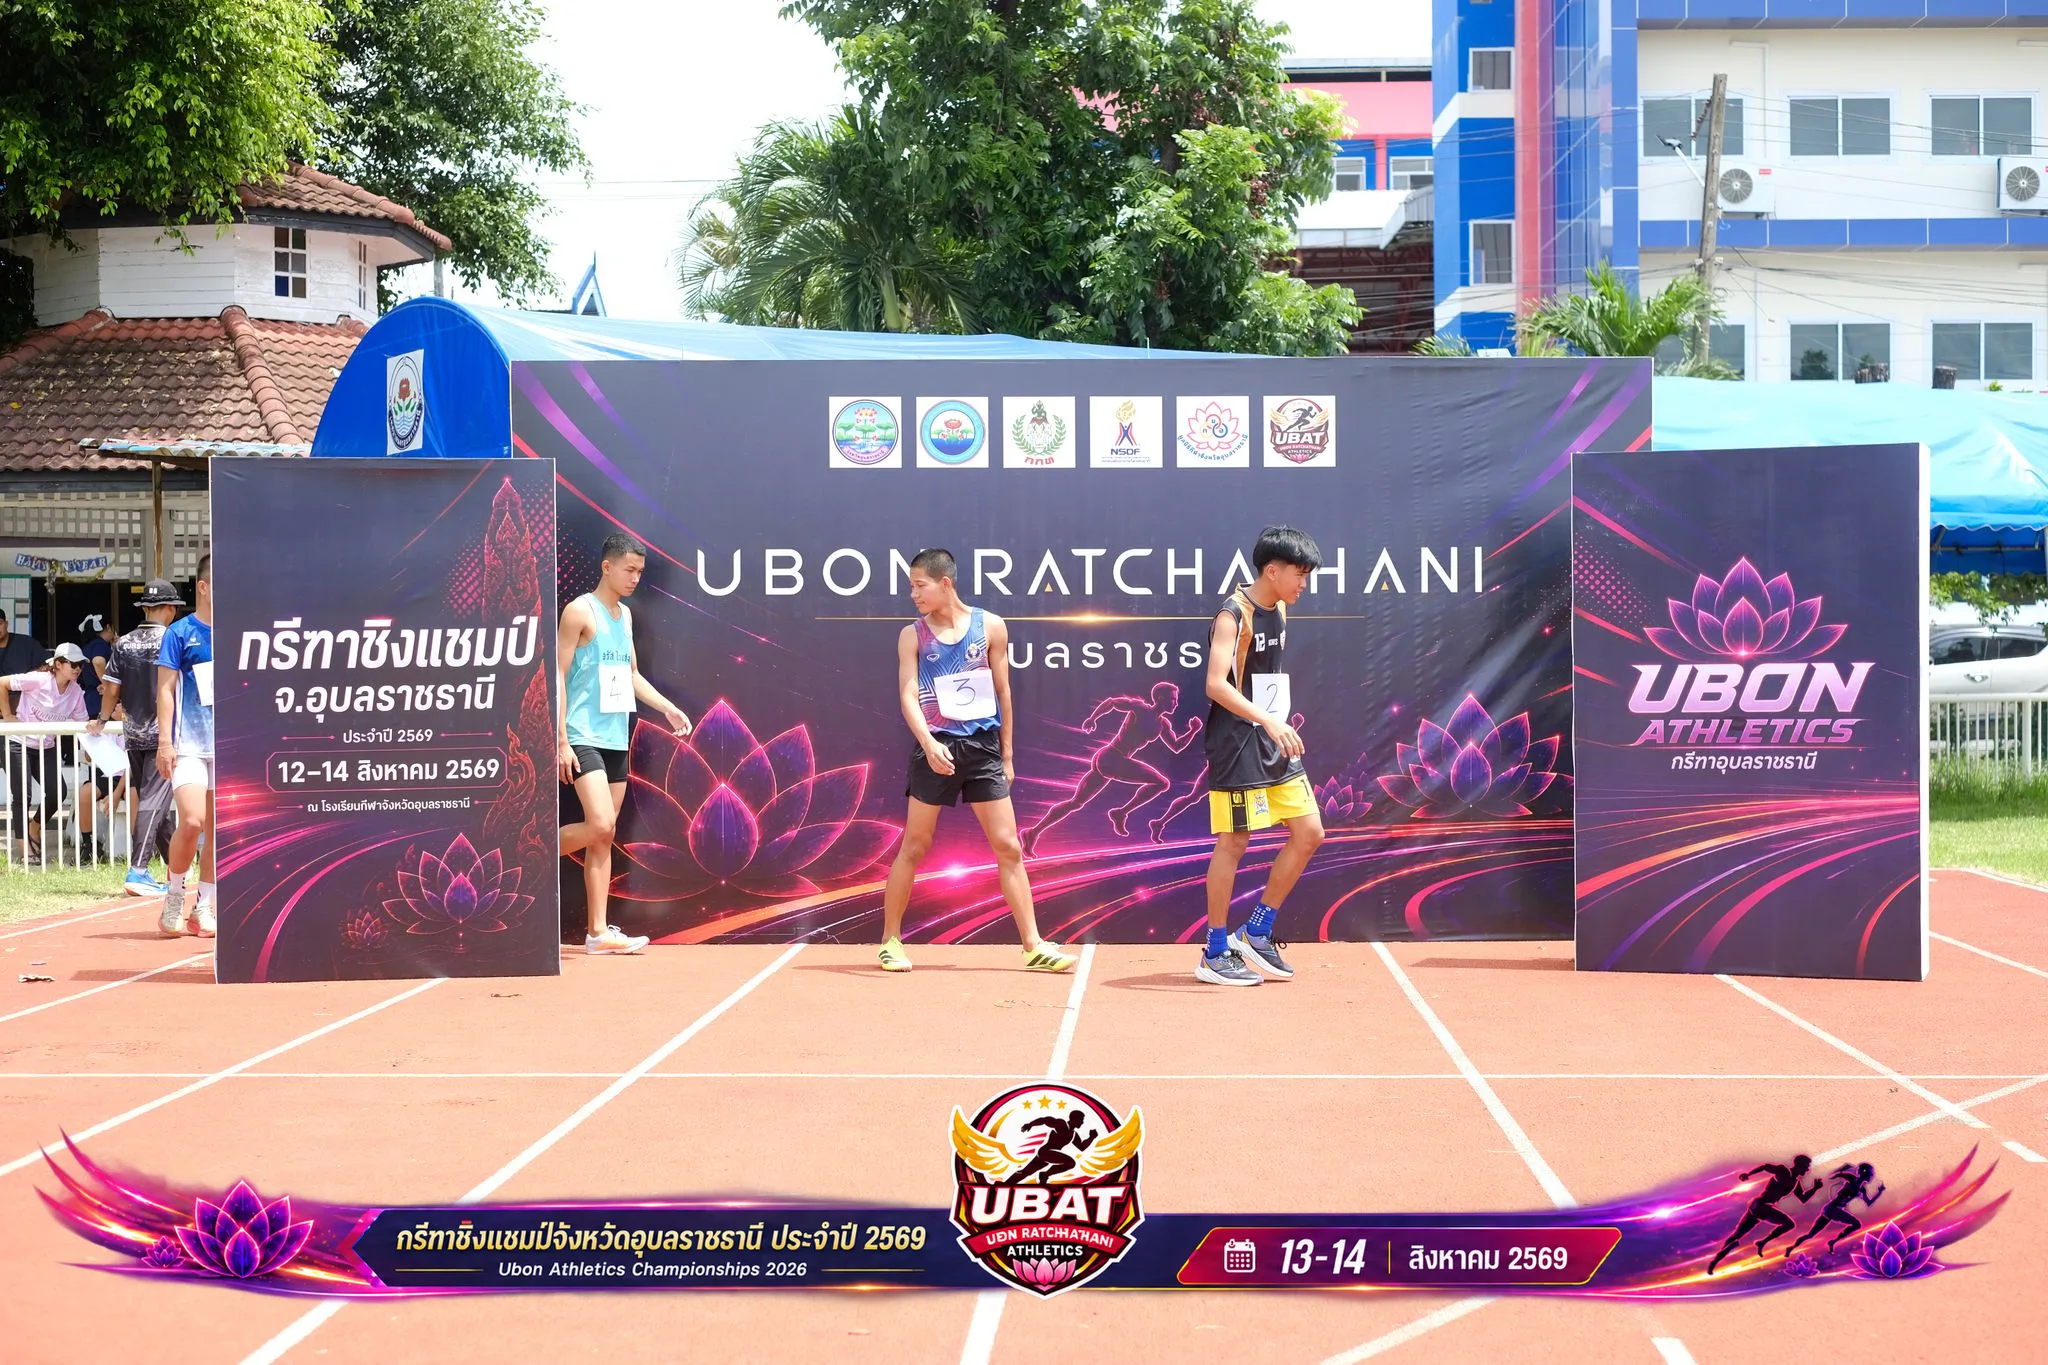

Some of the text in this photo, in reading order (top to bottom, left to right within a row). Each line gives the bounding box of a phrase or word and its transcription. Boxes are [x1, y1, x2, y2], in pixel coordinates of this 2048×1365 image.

[1110, 448, 1141, 456] NSDF
[1275, 431, 1325, 445] UBAT
[973, 547, 1483, 596] RATCHAHANI
[953, 678, 976, 706] 3
[1265, 683, 1279, 714] 2
[1628, 662, 1876, 714] UBON
[343, 728, 434, 744] ประจำปี 2569
[1627, 718, 1864, 746] ATHLETICS
[357, 759, 438, 782] สิงหาคม
[445, 758, 500, 780] 2569
